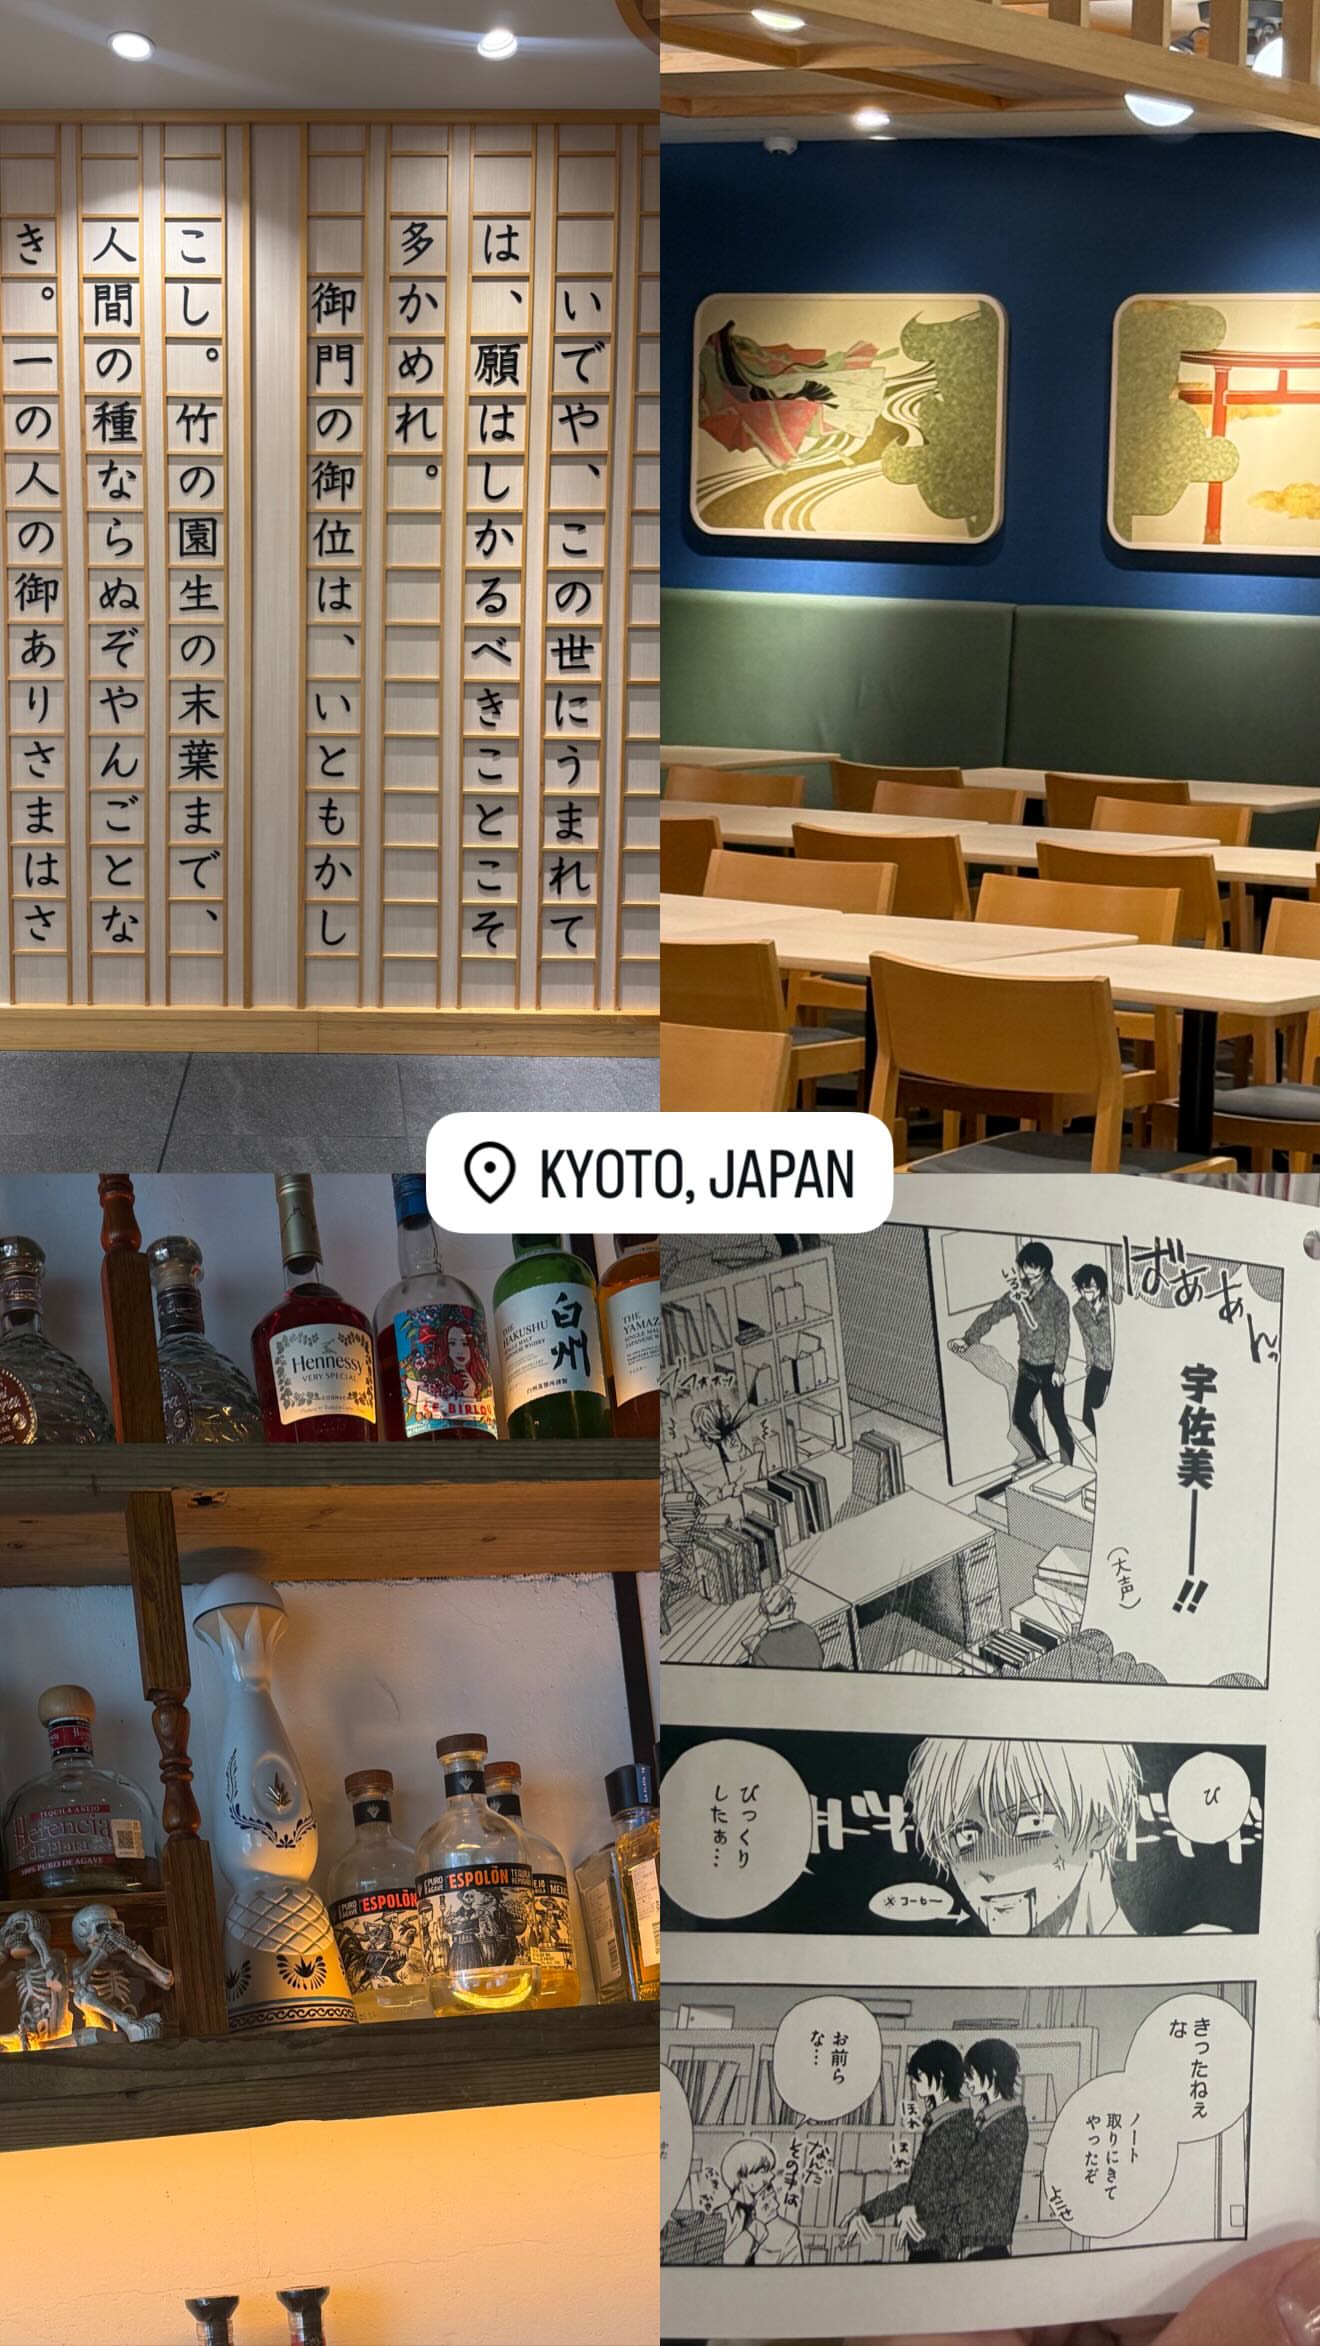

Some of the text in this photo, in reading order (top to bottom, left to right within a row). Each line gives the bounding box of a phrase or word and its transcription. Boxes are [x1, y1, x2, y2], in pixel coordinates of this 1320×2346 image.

[396, 221, 440, 478] 多かめれ。
[11, 223, 59, 942] き。一の人の御ありさまはさ
[91, 226, 140, 943] 人間の種ならぬぞやんごとな
[174, 227, 220, 923] こし。竹の園生の末葉まで、
[311, 281, 357, 947] 御門の御位は、いともかし
[471, 223, 521, 949] は、願はしかるべきことこそ
[549, 288, 605, 949] いでや、この世にうまれて
[292, 1355, 362, 1376] Hennessy
[551, 1291, 590, 1377] 白州
[738, 1784, 760, 1869] びっくり
[831, 2031, 848, 2085] お前ら
[1169, 2019, 1188, 2039] な
[1085, 2115, 1101, 2184] やったぞ
[1104, 2113, 1122, 2200] 取りにきて
[1130, 2113, 1140, 2164] ノート
